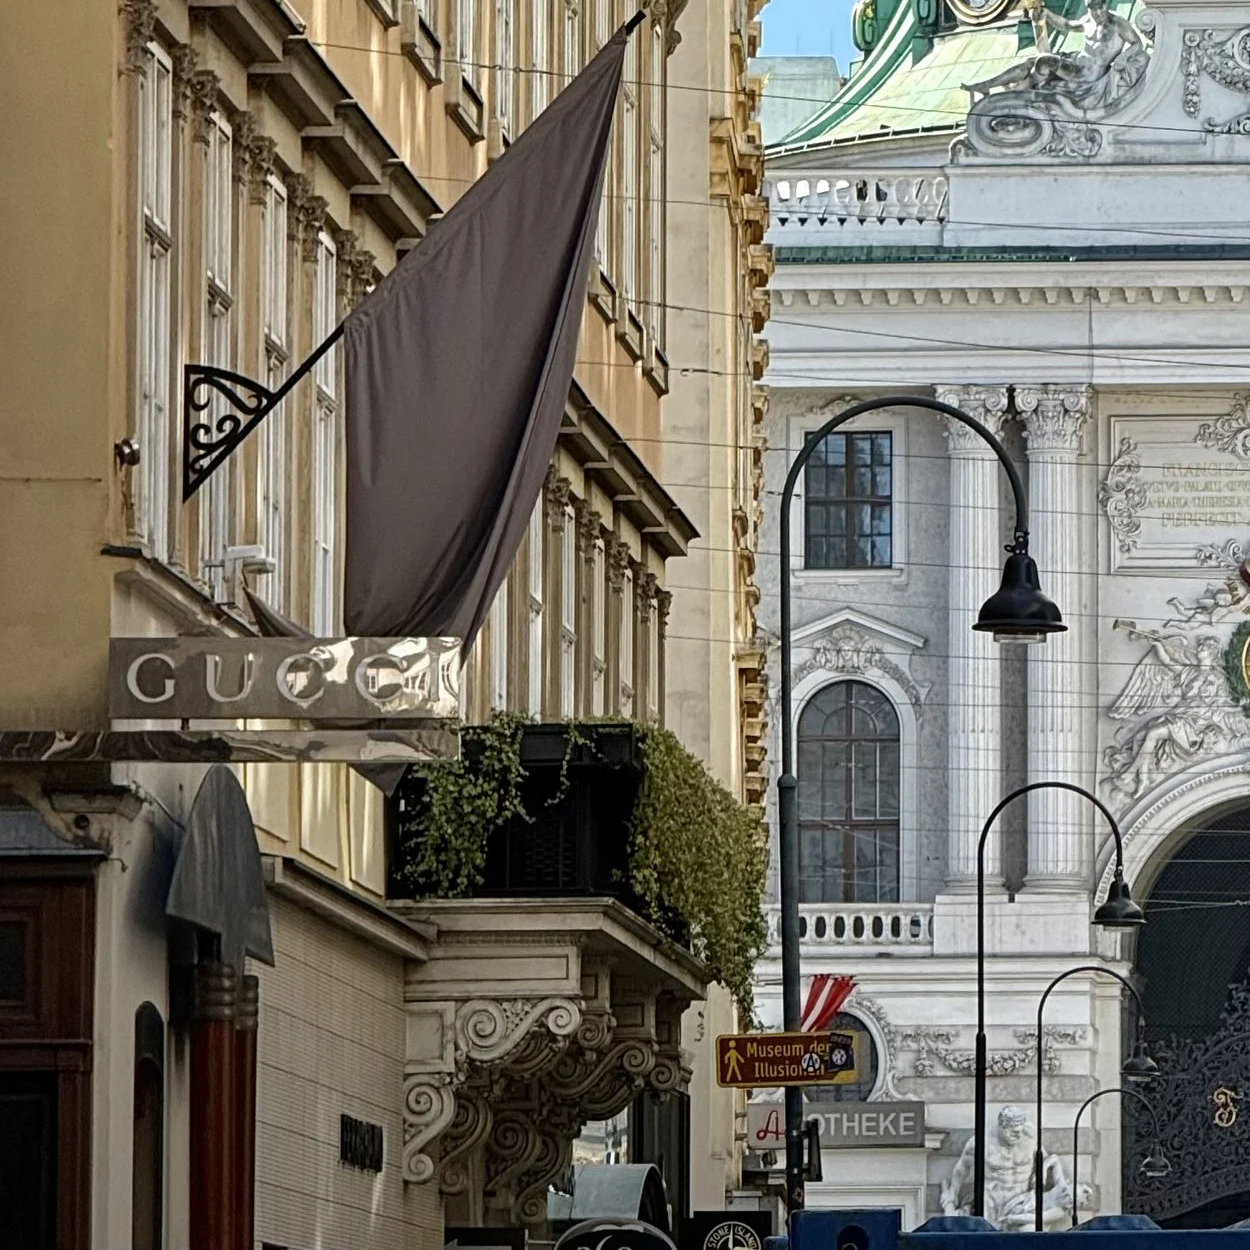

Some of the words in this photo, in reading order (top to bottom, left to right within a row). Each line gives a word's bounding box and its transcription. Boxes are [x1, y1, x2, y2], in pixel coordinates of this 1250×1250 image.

[126, 652, 441, 704] GUCCI
[746, 1041, 805, 1059] Museum
[808, 1040, 833, 1056] der
[756, 1110, 915, 1141] AOTHEKE
[707, 1225, 730, 1248] STONE
[734, 1225, 758, 1250] ISLAND
